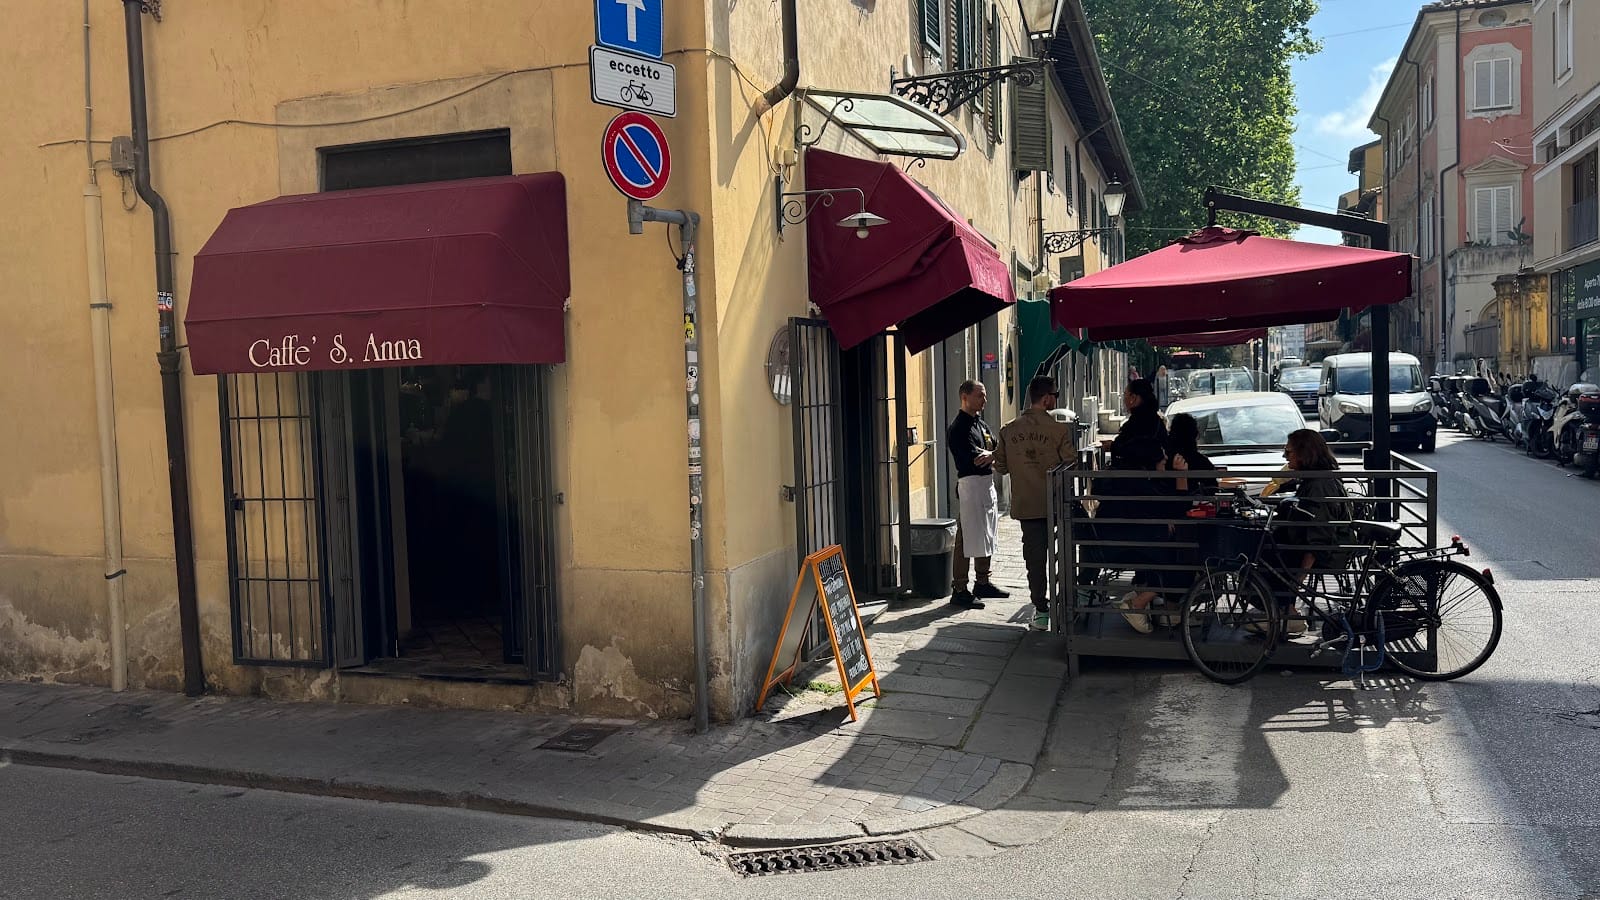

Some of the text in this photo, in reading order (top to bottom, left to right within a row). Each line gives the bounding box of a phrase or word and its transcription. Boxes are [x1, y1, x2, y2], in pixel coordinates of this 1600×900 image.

[610, 60, 660, 80] eccetto
[248, 332, 424, 367] Caffe' S. Anna
